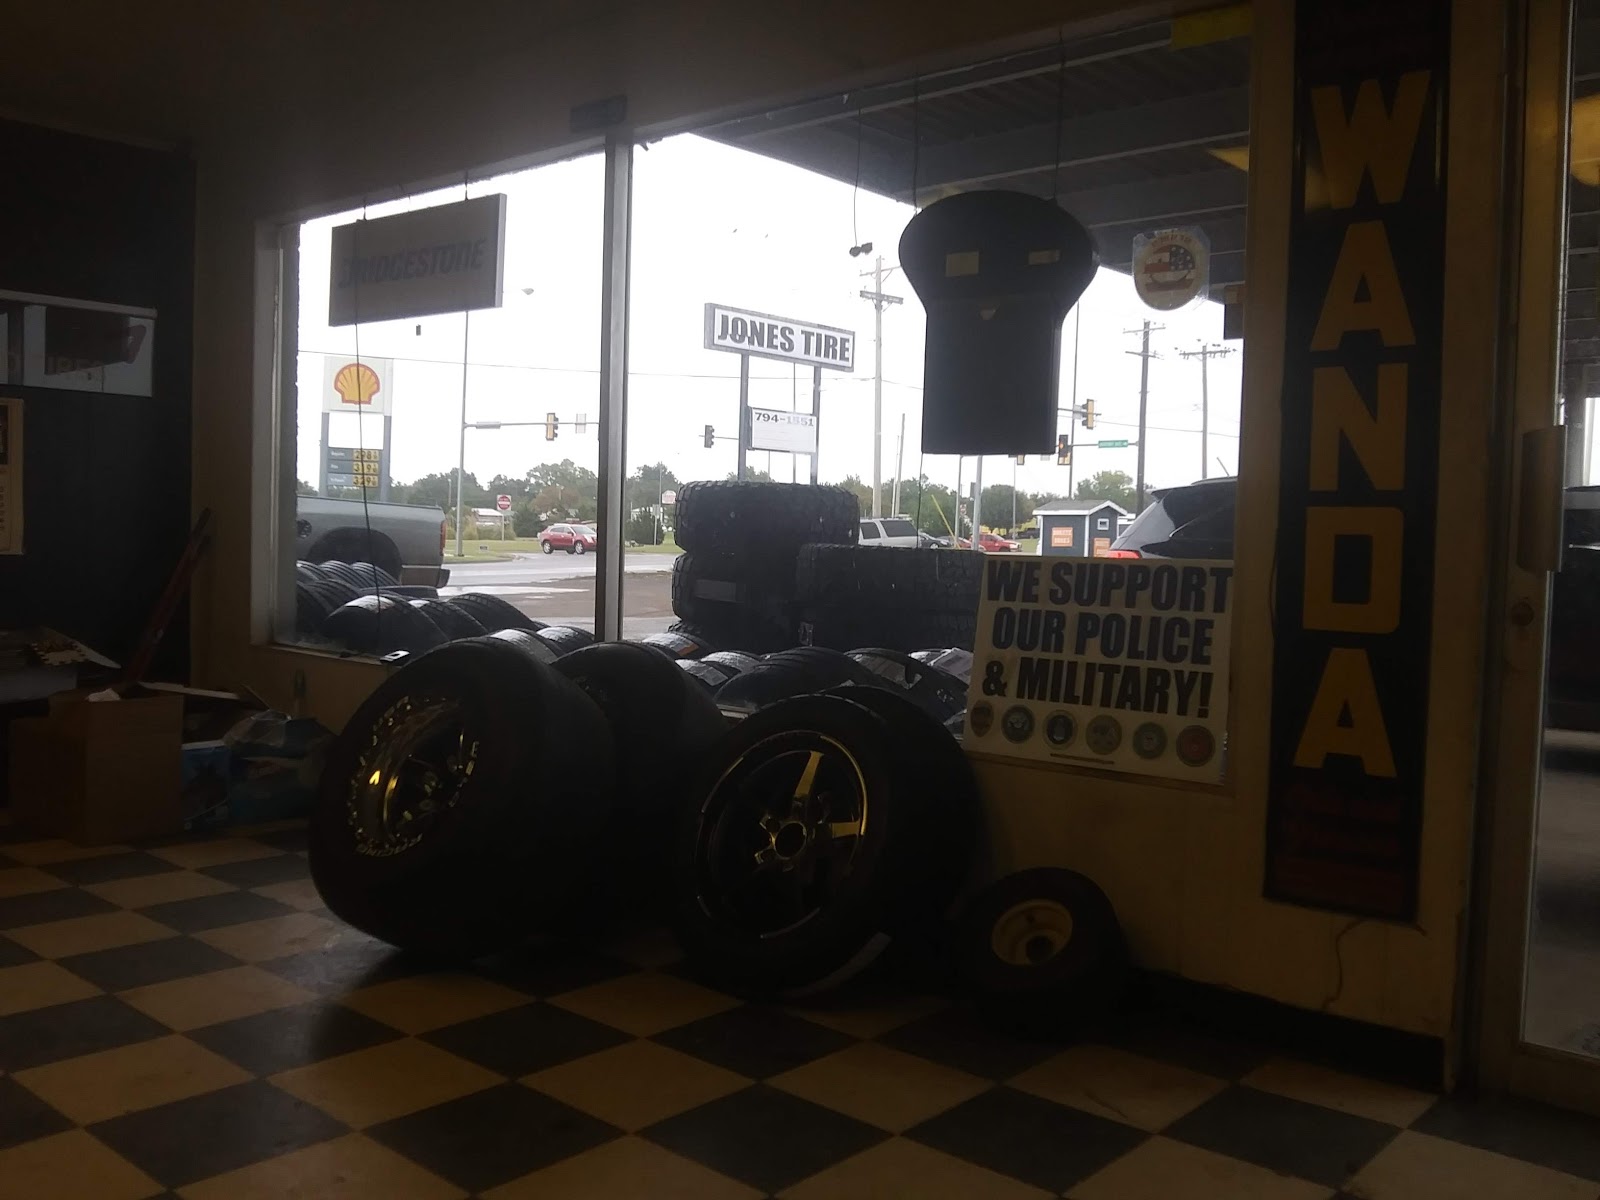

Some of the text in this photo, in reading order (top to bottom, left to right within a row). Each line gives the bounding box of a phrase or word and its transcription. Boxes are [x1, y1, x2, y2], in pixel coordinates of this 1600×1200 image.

[717, 314, 850, 362] JONES TIRE
[754, 411, 815, 427] 794-1551
[1293, 70, 1432, 779] WANDA
[986, 560, 1234, 613] WE SUPPORT
[992, 607, 1215, 665] OUR POLICE
[982, 660, 1008, 697] &
[1016, 657, 1214, 719] MILITARY!
